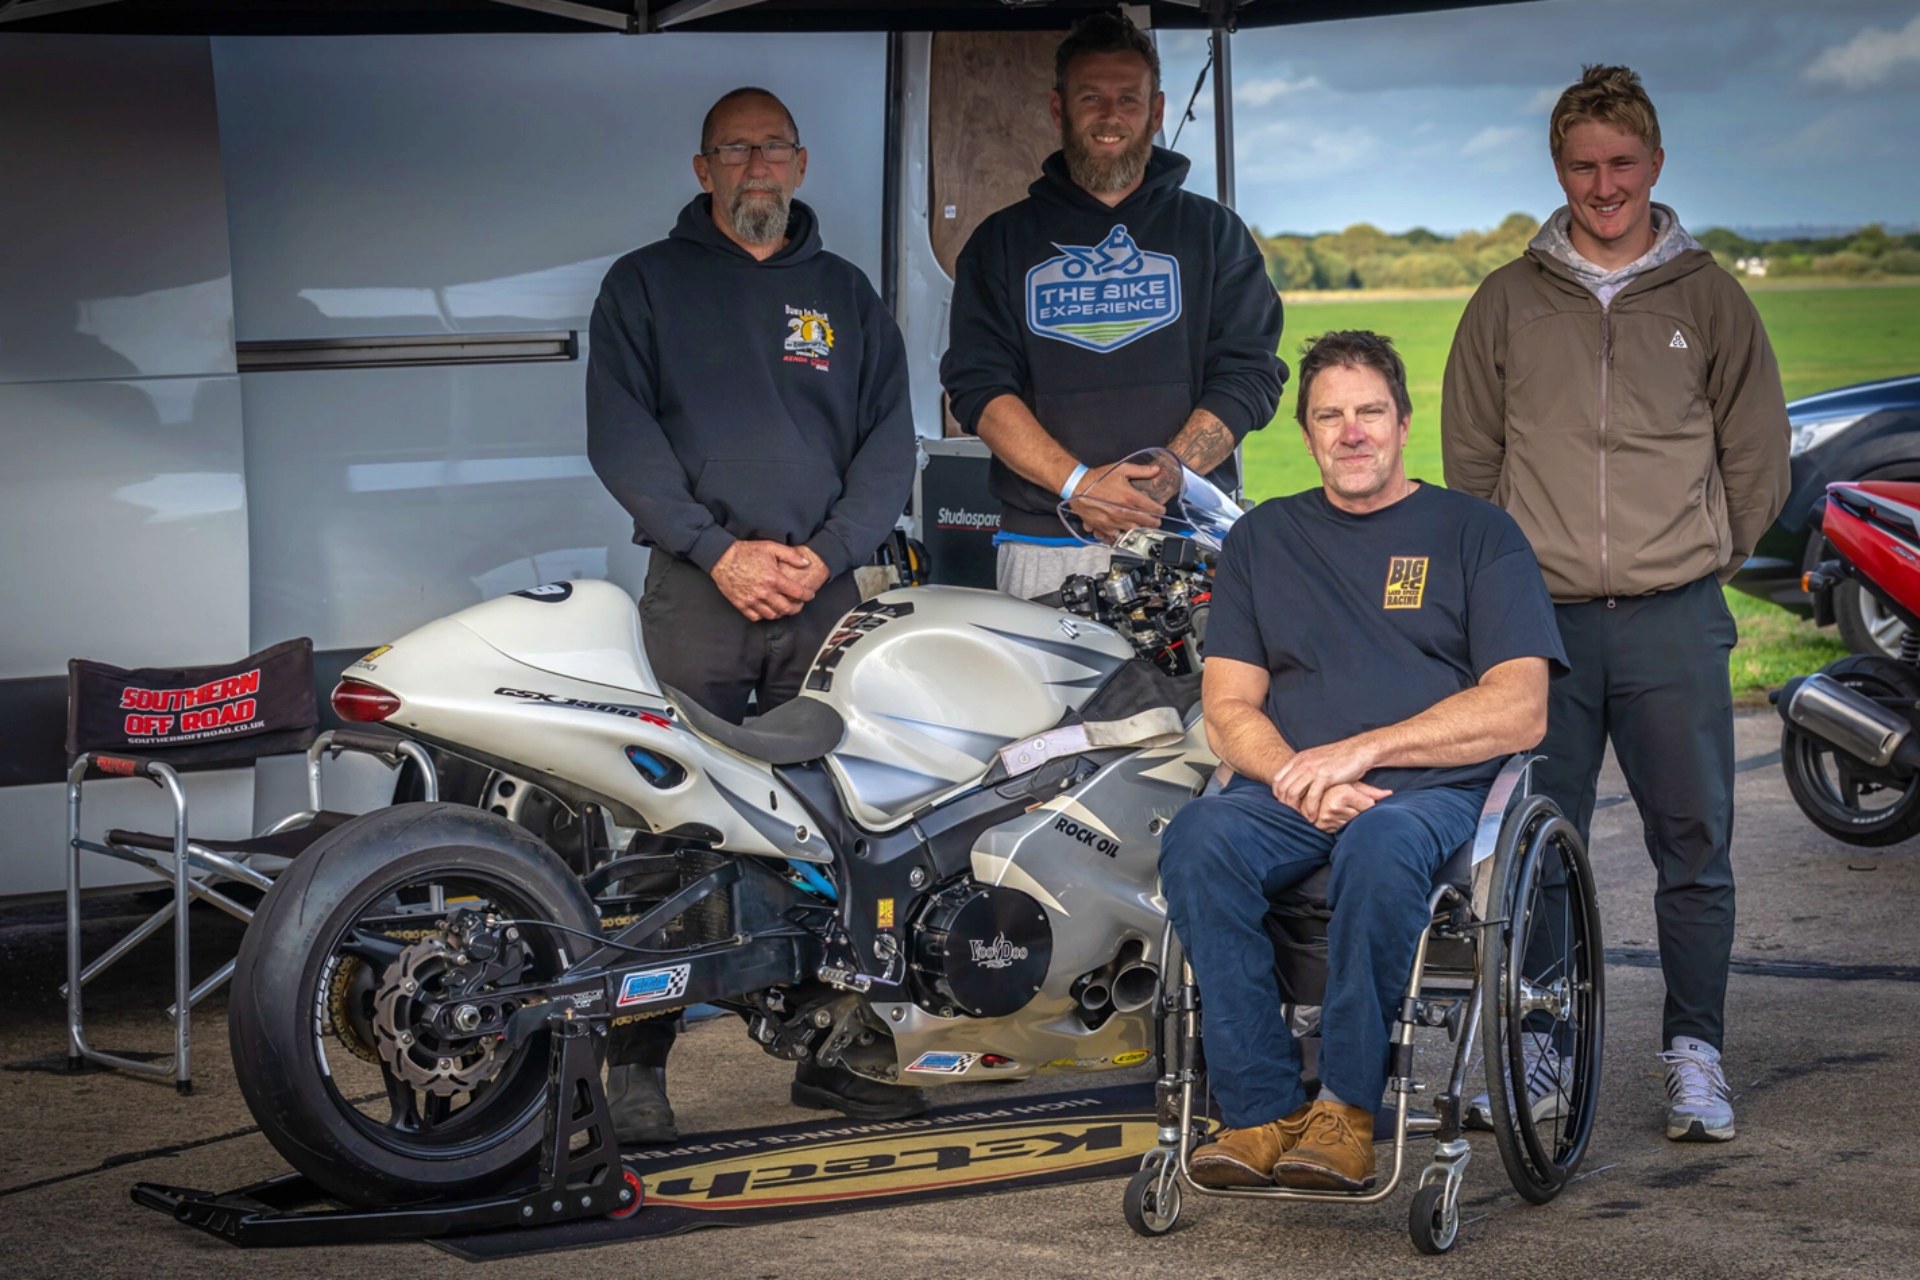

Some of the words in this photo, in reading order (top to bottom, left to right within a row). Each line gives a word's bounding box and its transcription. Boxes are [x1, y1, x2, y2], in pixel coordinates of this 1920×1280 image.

[1040, 286, 1097, 304] THE
[1103, 280, 1166, 299] BIKE
[1040, 298, 1167, 319] EXPERIENCE
[1390, 559, 1425, 584] BIG
[1387, 595, 1420, 607] RACING
[119, 668, 261, 712] SOUTHERN
[124, 713, 175, 736] OFF
[180, 698, 257, 733] ROAD
[127, 720, 266, 744] SOUTHERNOFFROAD.CO.UK
[1054, 817, 1098, 847] ROCK
[1096, 838, 1120, 858] OIL
[1013, 1098, 1102, 1114] HIGH
[765, 1109, 1014, 1146] PERFORMANCE
